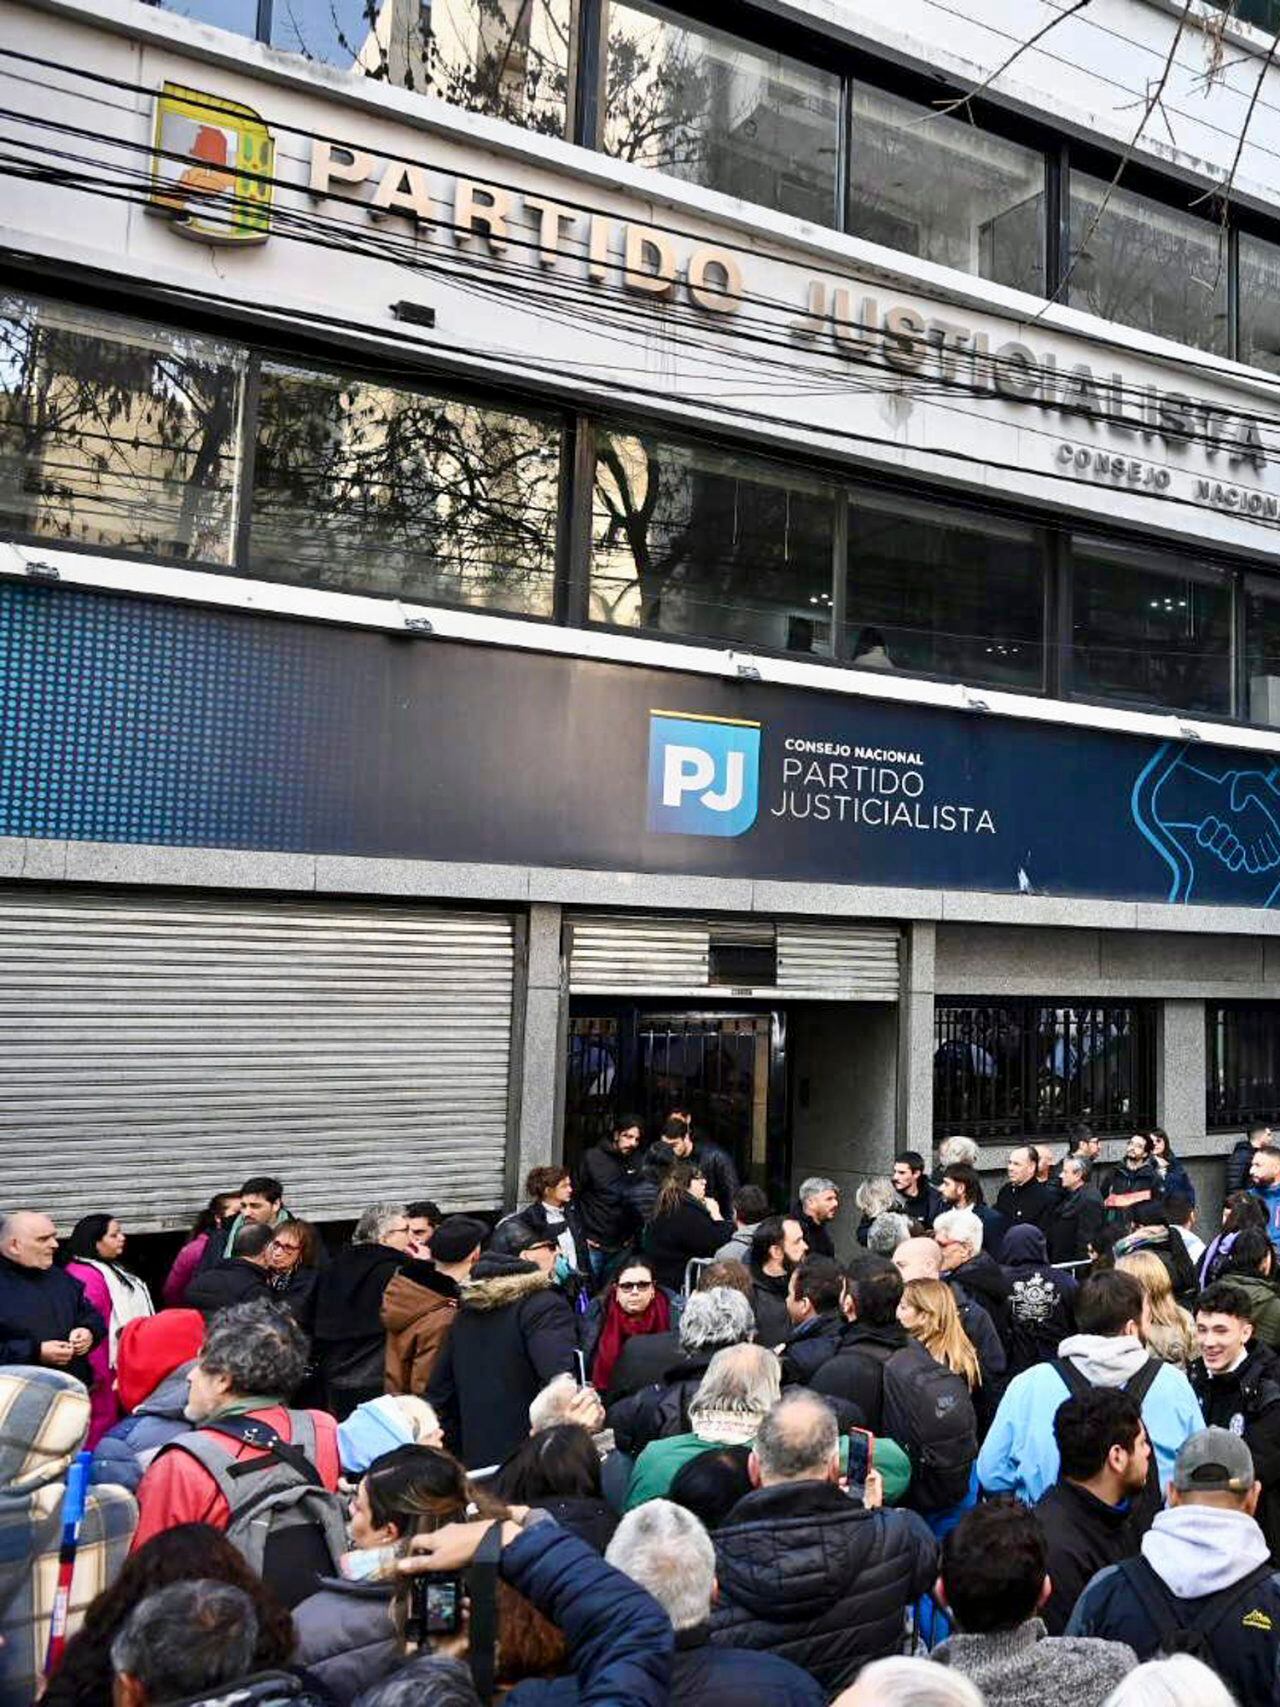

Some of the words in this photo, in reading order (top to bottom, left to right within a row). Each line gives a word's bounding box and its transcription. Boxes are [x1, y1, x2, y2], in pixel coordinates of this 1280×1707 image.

[308, 139, 743, 314] PARTIDO
[790, 281, 1269, 468] JUSTICIALISTA
[1056, 443, 1172, 490] CONSEJO
[784, 738, 851, 757] CONSEJO
[854, 746, 924, 765] NACIONAL
[662, 744, 745, 812] PJ
[782, 758, 924, 798] PARTIDO
[770, 791, 996, 834] JUSTICIALISTA
